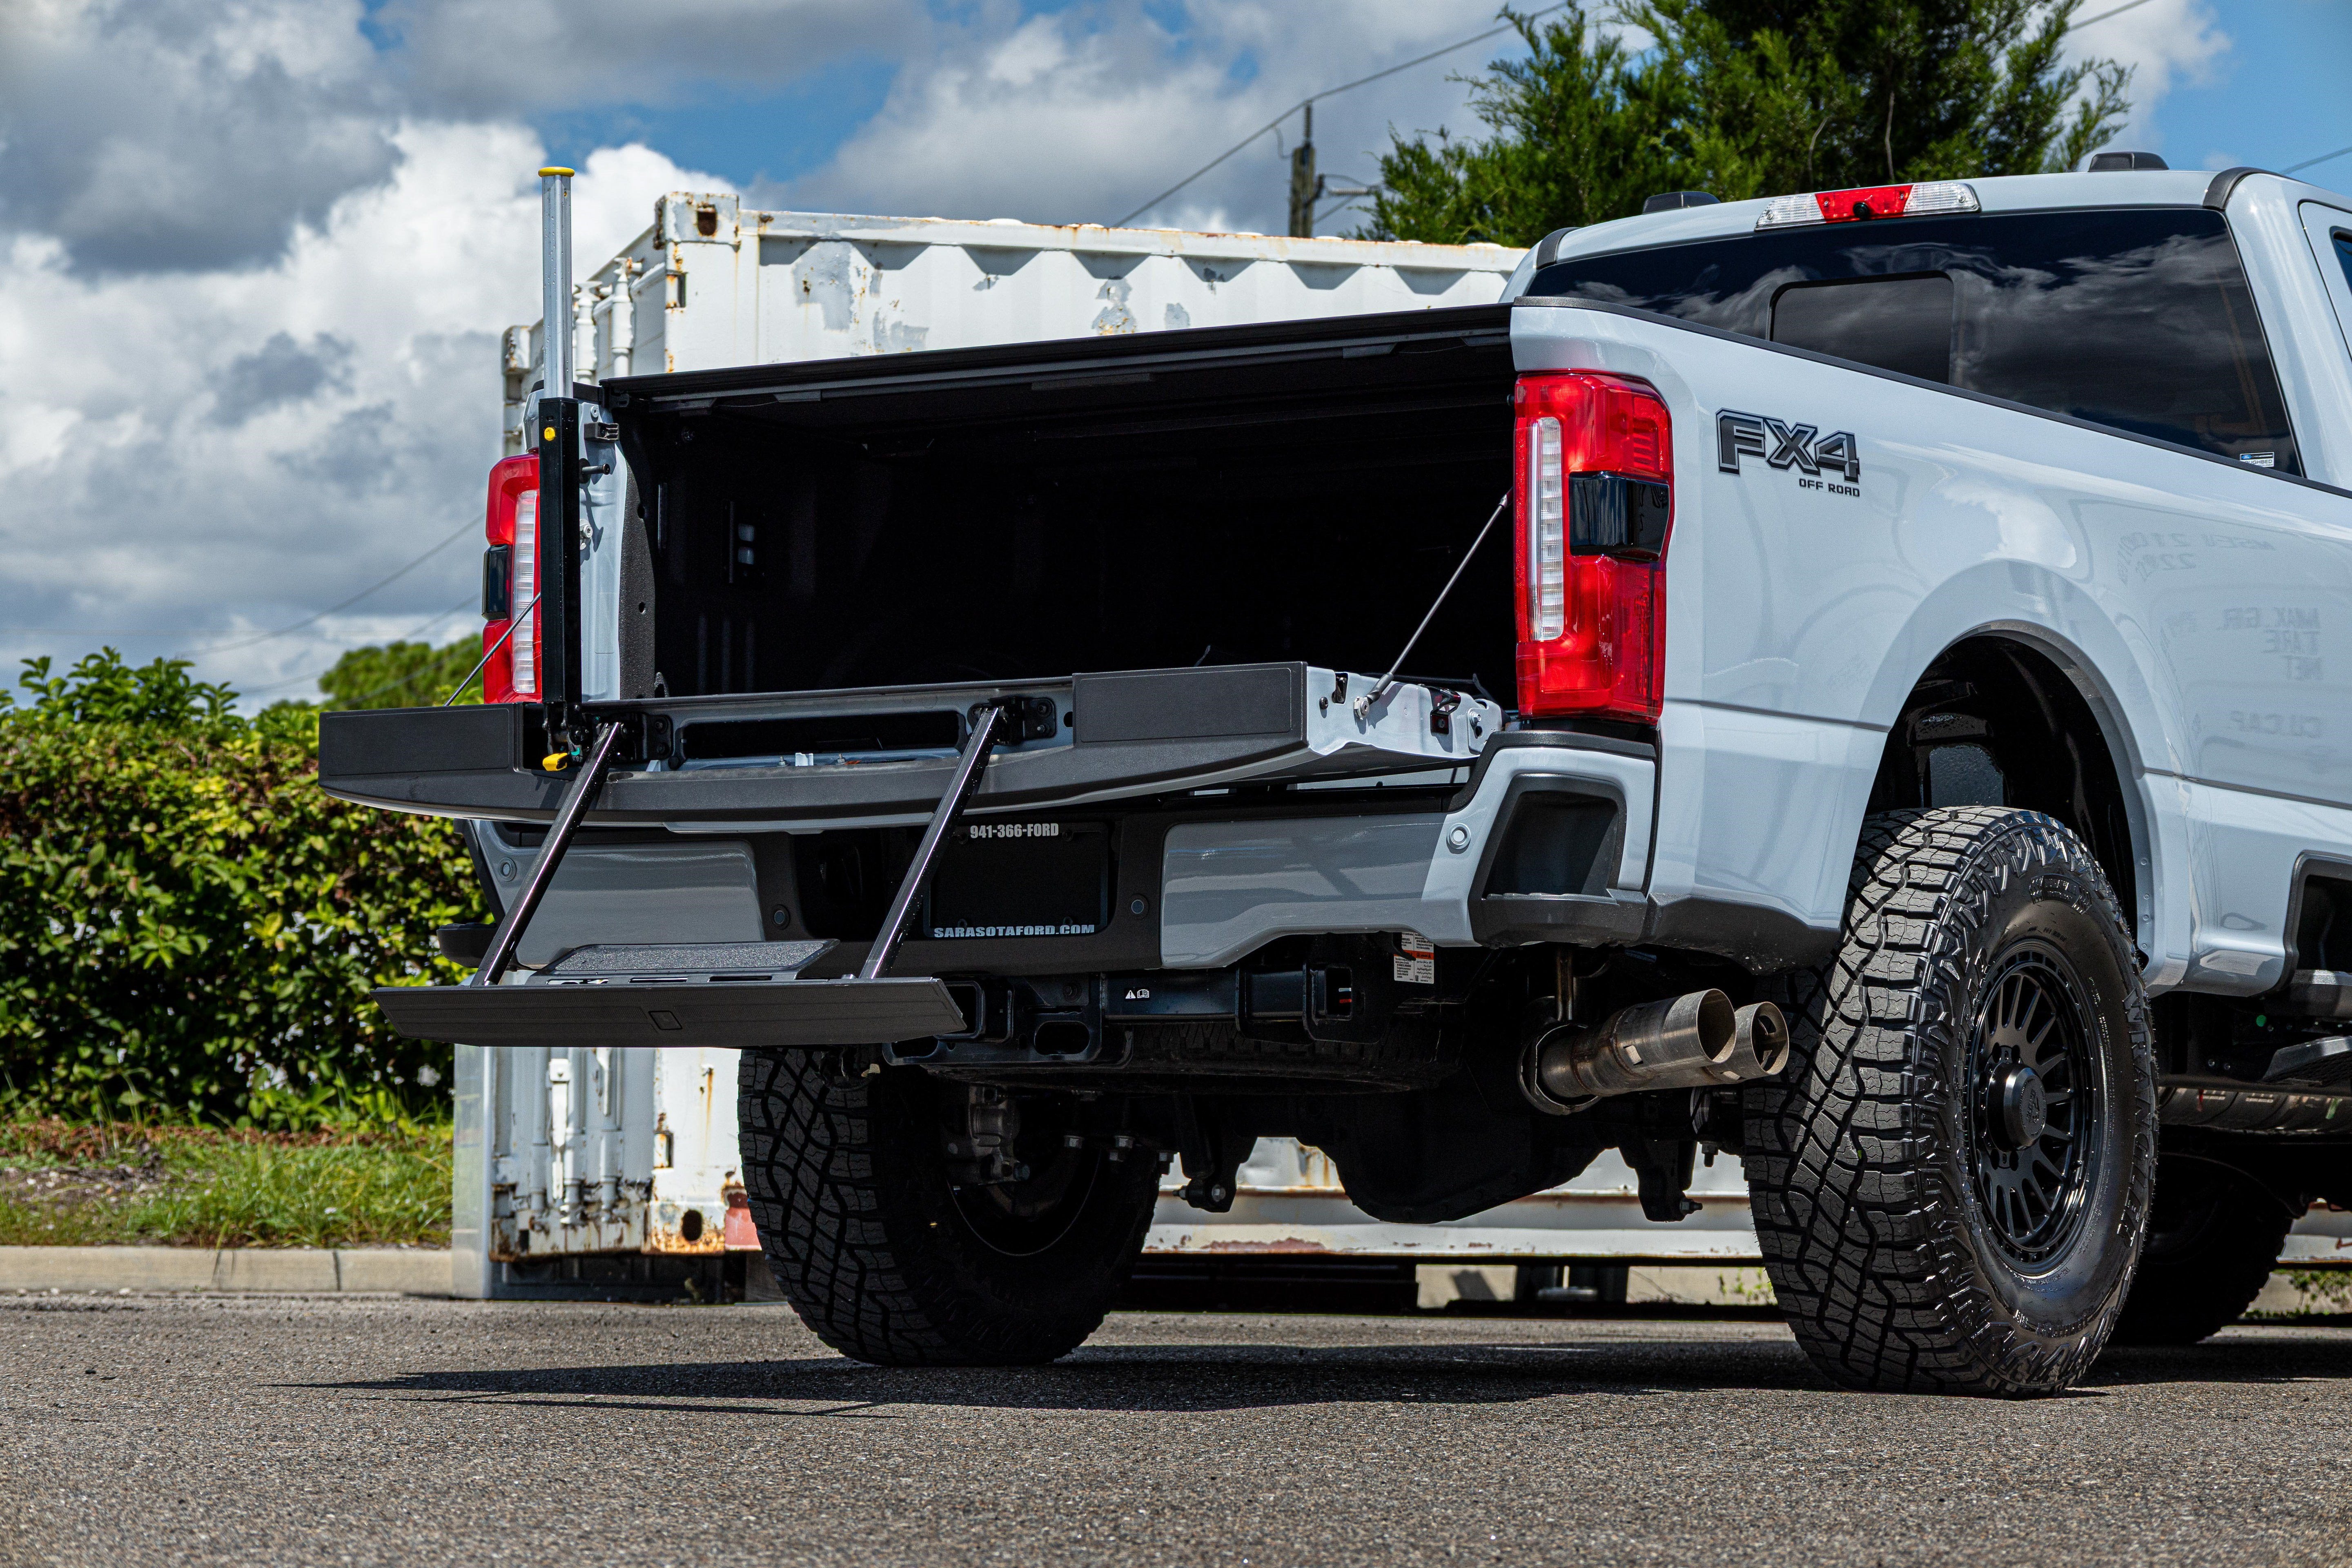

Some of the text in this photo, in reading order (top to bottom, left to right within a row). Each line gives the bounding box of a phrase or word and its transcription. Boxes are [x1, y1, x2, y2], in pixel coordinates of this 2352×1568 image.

[1715, 408, 1861, 485] FX4
[1799, 477, 1860, 498] OFF ROAD
[970, 823, 1058, 838] 941-366-FORD
[934, 924, 1095, 938] SARASOTAFORD.COM
[2116, 987, 2151, 1247] WRANGLER
